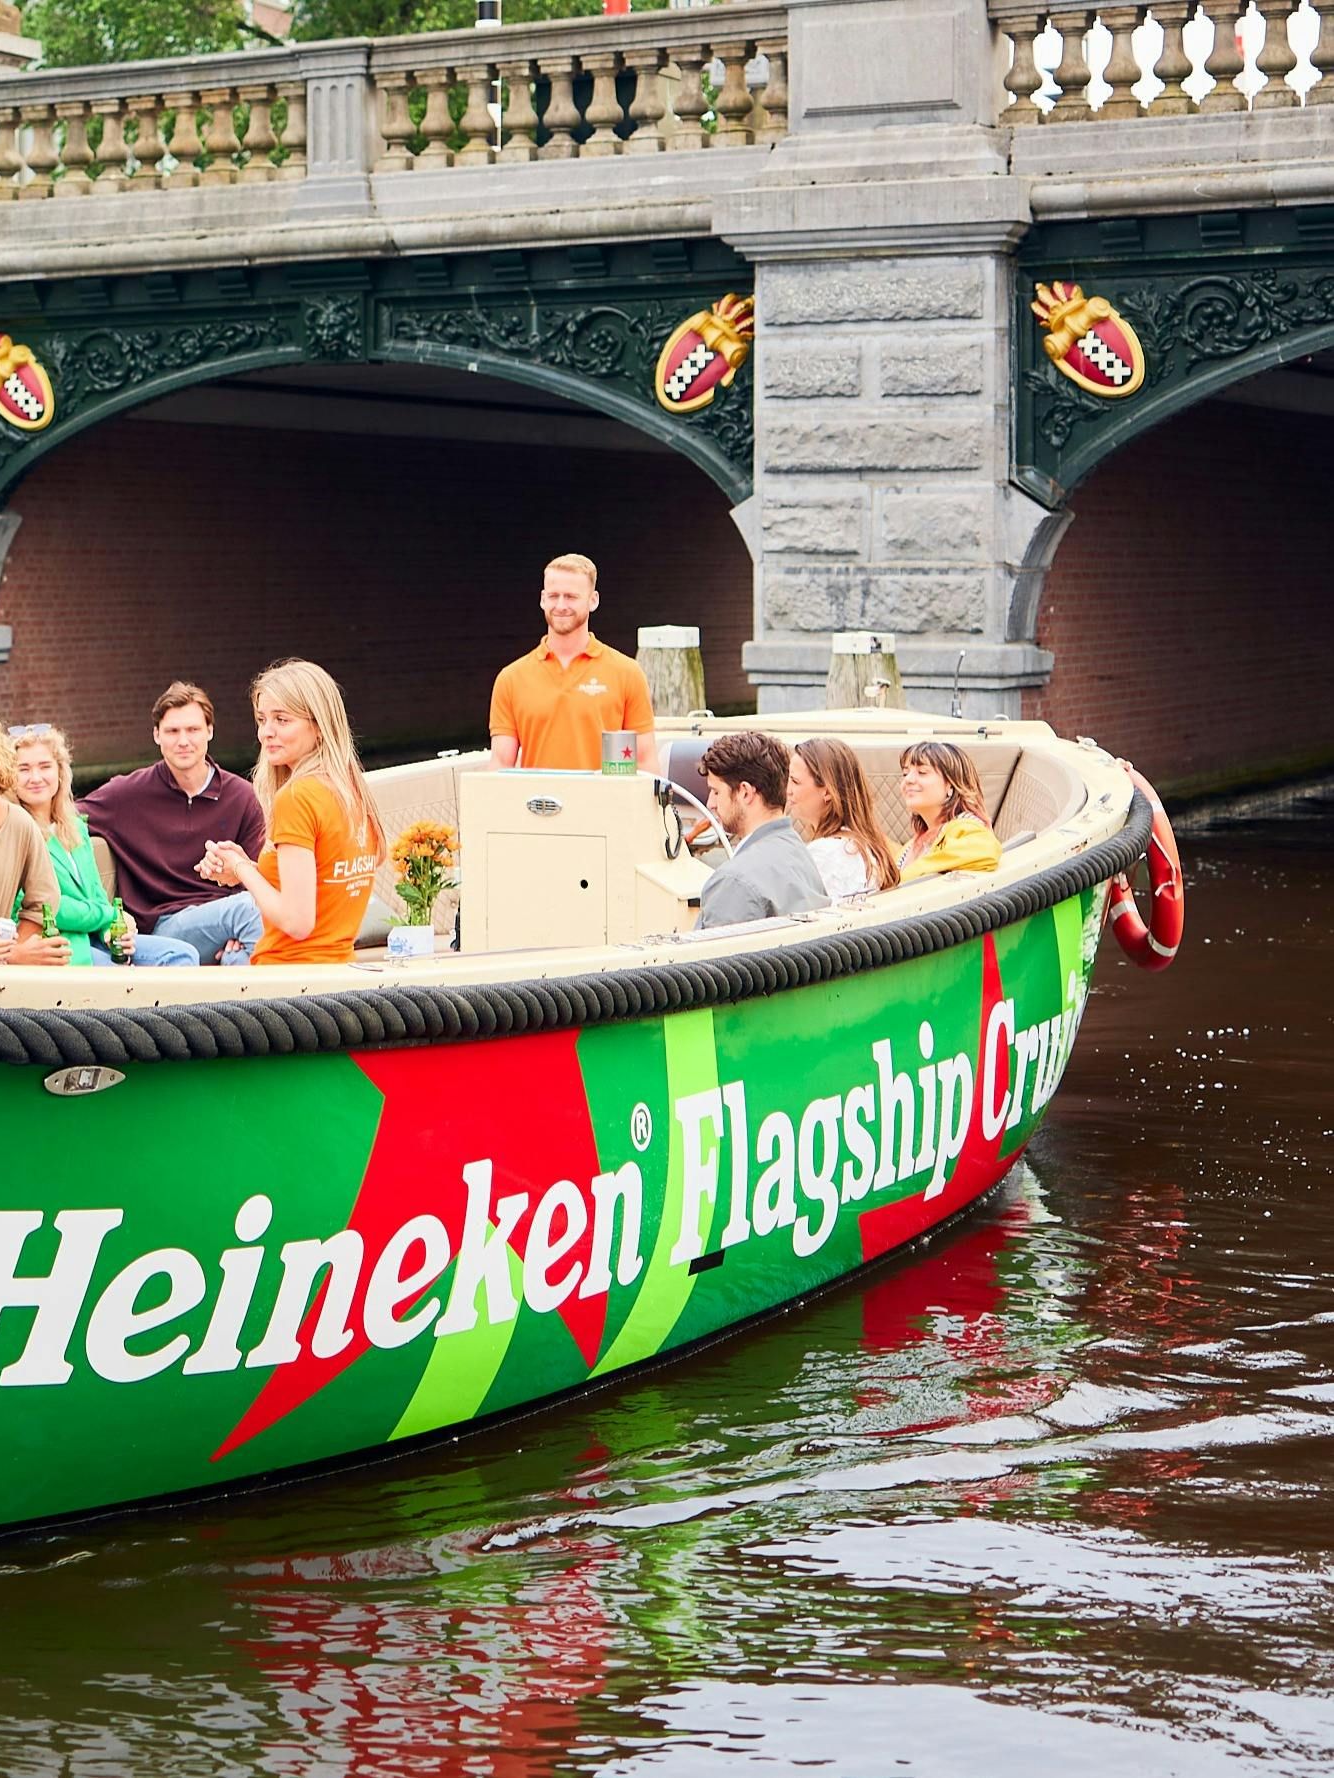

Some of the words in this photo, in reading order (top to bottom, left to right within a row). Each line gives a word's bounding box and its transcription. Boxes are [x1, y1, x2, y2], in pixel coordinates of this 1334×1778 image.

[333, 855, 377, 878] FLAGSHI
[669, 1020, 974, 1268] Flagship
[981, 970, 1084, 1142] Crui
